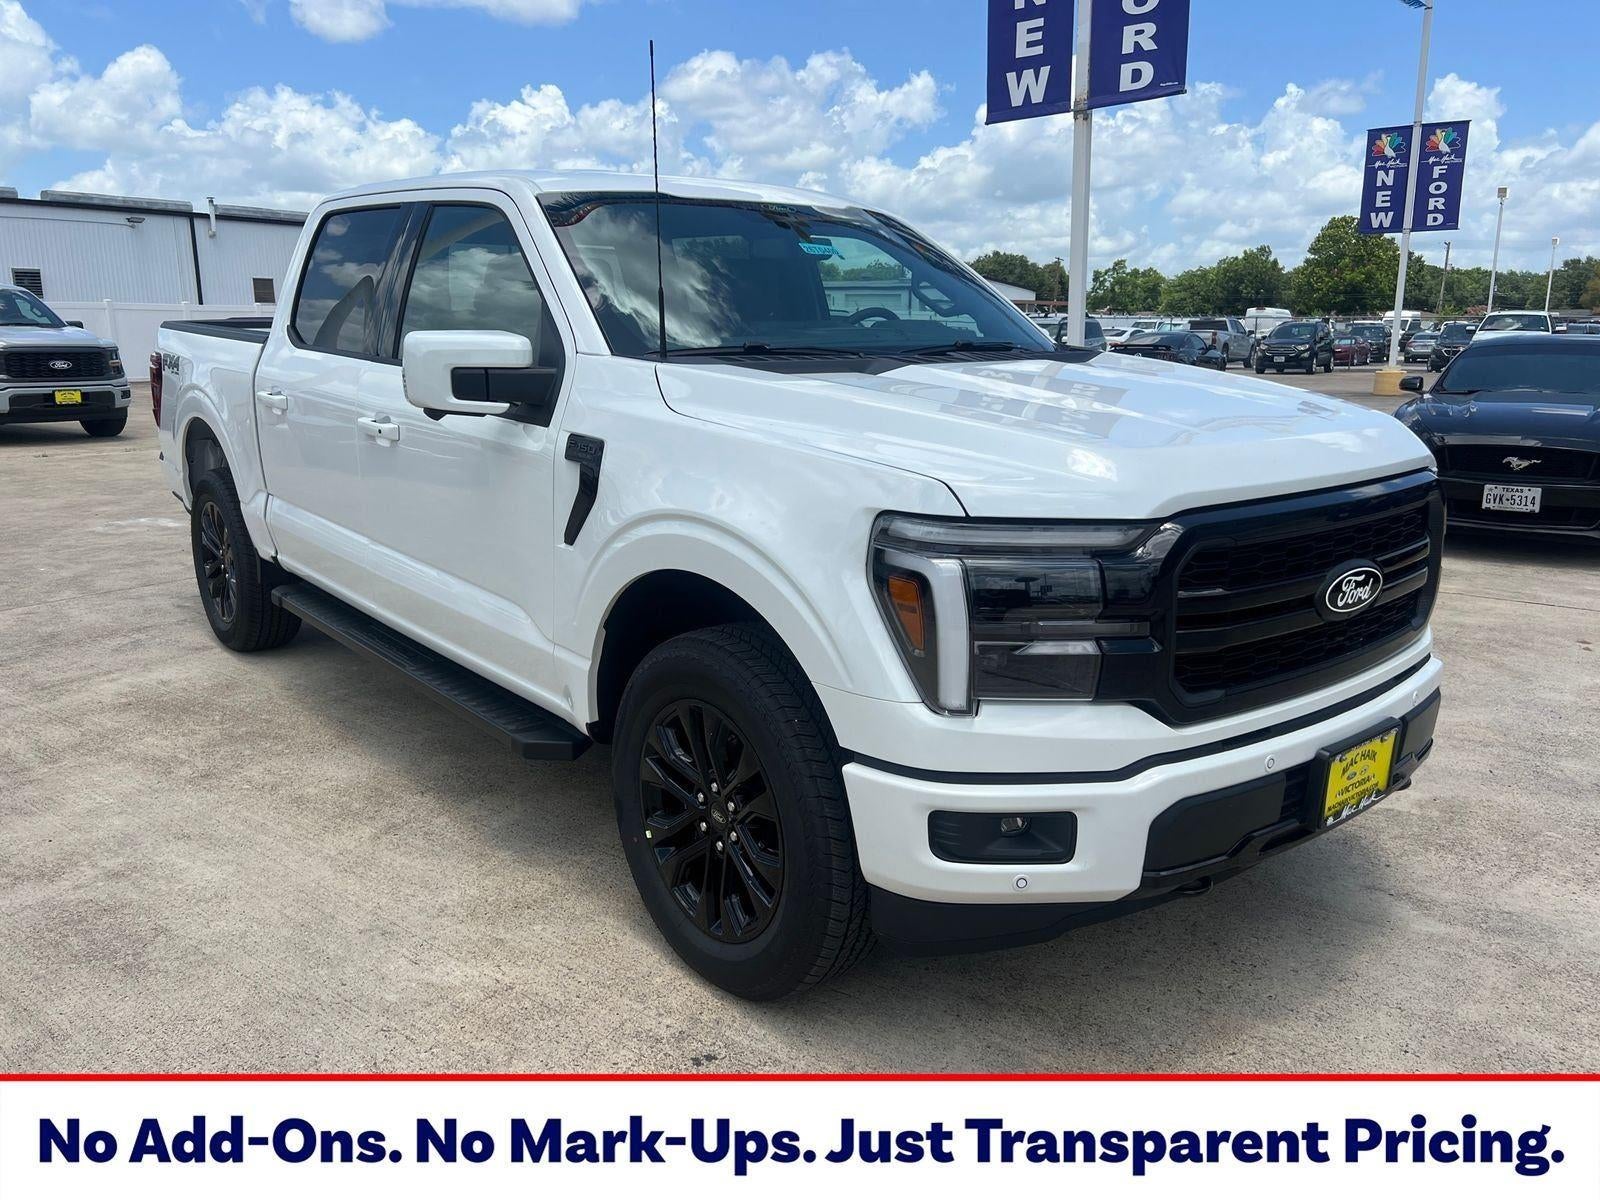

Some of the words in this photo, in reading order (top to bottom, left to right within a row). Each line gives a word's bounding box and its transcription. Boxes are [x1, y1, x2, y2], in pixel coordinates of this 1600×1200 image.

[1370, 169, 1395, 229] NEW
[1426, 165, 1448, 226] FORD
[1502, 487, 1524, 496] TEXAS
[1337, 574, 1373, 607] Ford
[1341, 754, 1360, 777] MAC
[1359, 748, 1378, 763] HAIK
